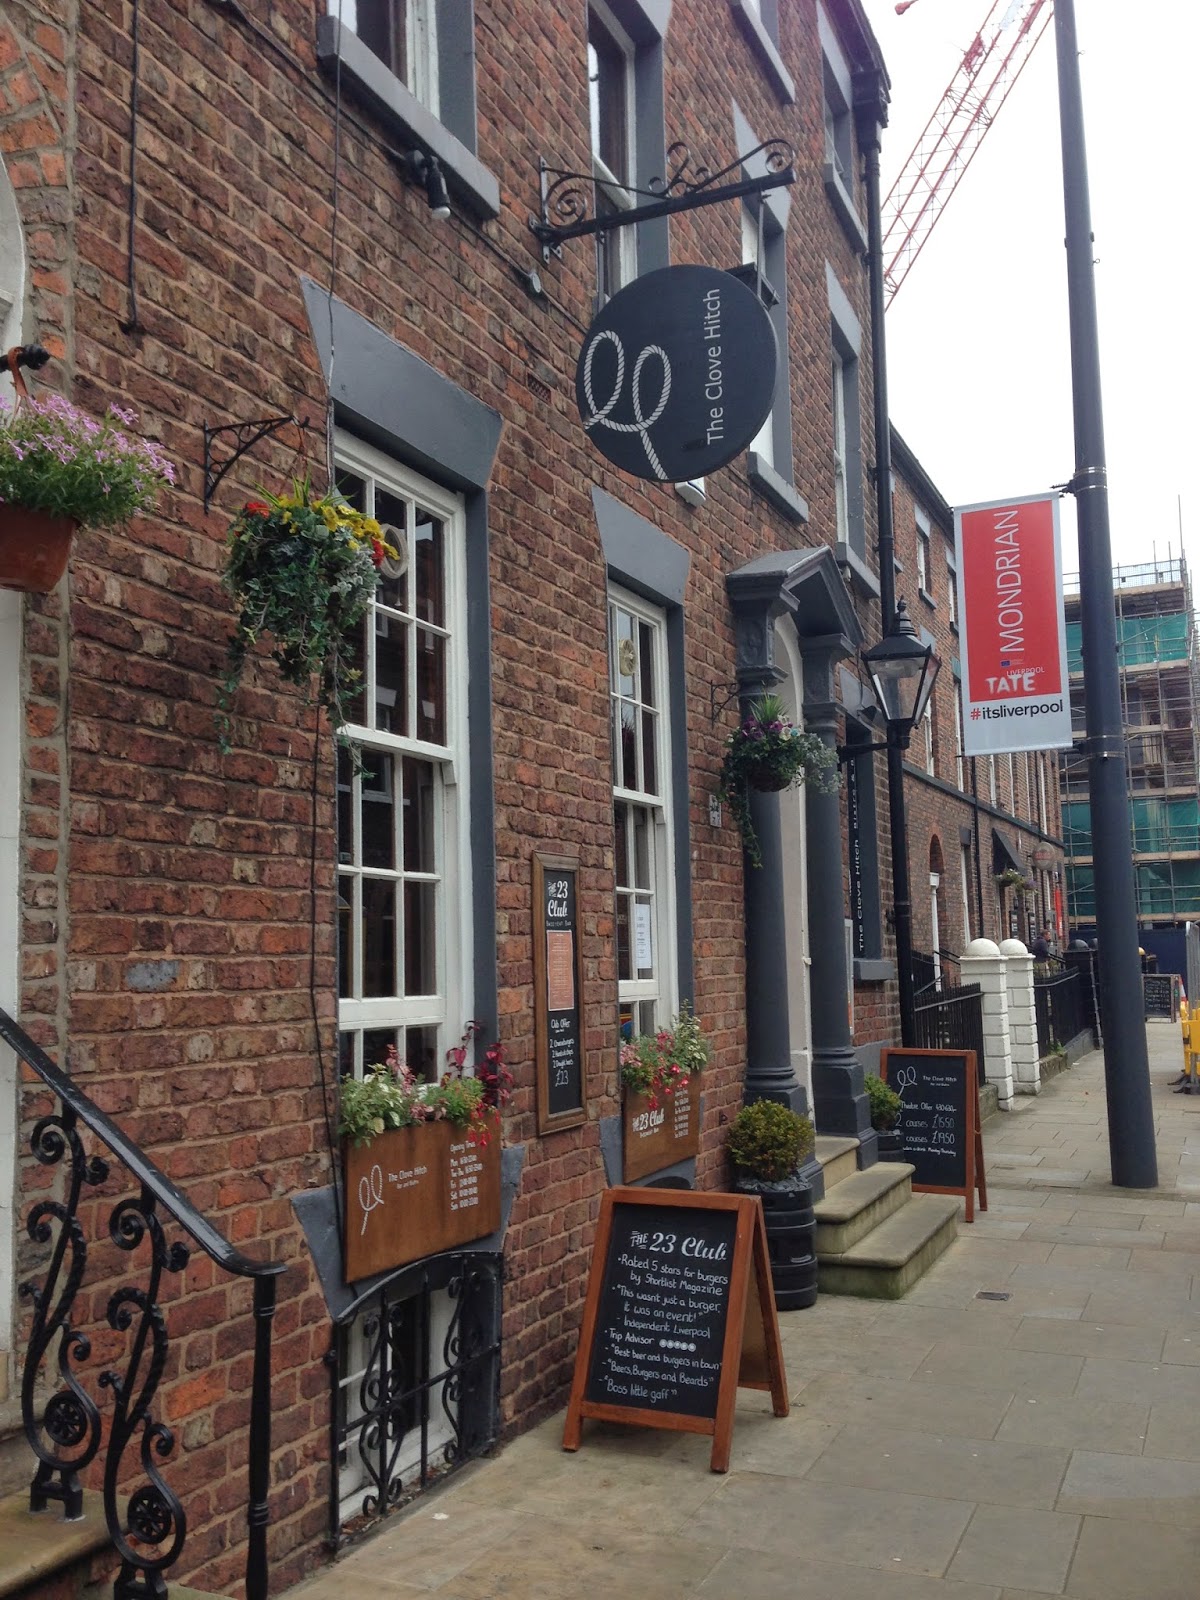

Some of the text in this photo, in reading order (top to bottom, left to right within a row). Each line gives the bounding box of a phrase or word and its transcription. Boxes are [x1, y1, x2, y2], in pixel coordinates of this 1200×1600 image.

[702, 288, 724, 445] The Clove Hitch
[993, 509, 1025, 653] MONDRIAN
[1006, 666, 1046, 677] LIVERPOOL
[985, 672, 1036, 694] TATE
[970, 699, 1064, 721] #itsliverpool
[557, 880, 568, 899] 23
[548, 899, 568, 917] Club
[639, 1112, 649, 1131] 23
[649, 1107, 665, 1128] Club
[895, 1112, 902, 1127] 2
[905, 1119, 928, 1128] courses
[388, 1173, 398, 1182] The
[399, 1170, 413, 1180] Clove
[630, 1232, 727, 1260] THE 23 Club
[651, 1260, 659, 1271] 5
[661, 1264, 681, 1276] stars
[684, 1267, 696, 1278] for
[697, 1269, 729, 1286] burgers
[630, 1270, 723, 1296] by Shortlist Magazine
[661, 1295, 678, 1306] just
[633, 1305, 651, 1316] was
[653, 1310, 665, 1319] an
[609, 1327, 655, 1345] Trip Advisor
[624, 1315, 711, 1339] Independent Liverpool
[632, 1349, 647, 1361] beer
[647, 1353, 660, 1362] and
[663, 1353, 691, 1369] burgers
[691, 1359, 700, 1368] in
[661, 1372, 677, 1383] and
[630, 1383, 649, 1398] little
